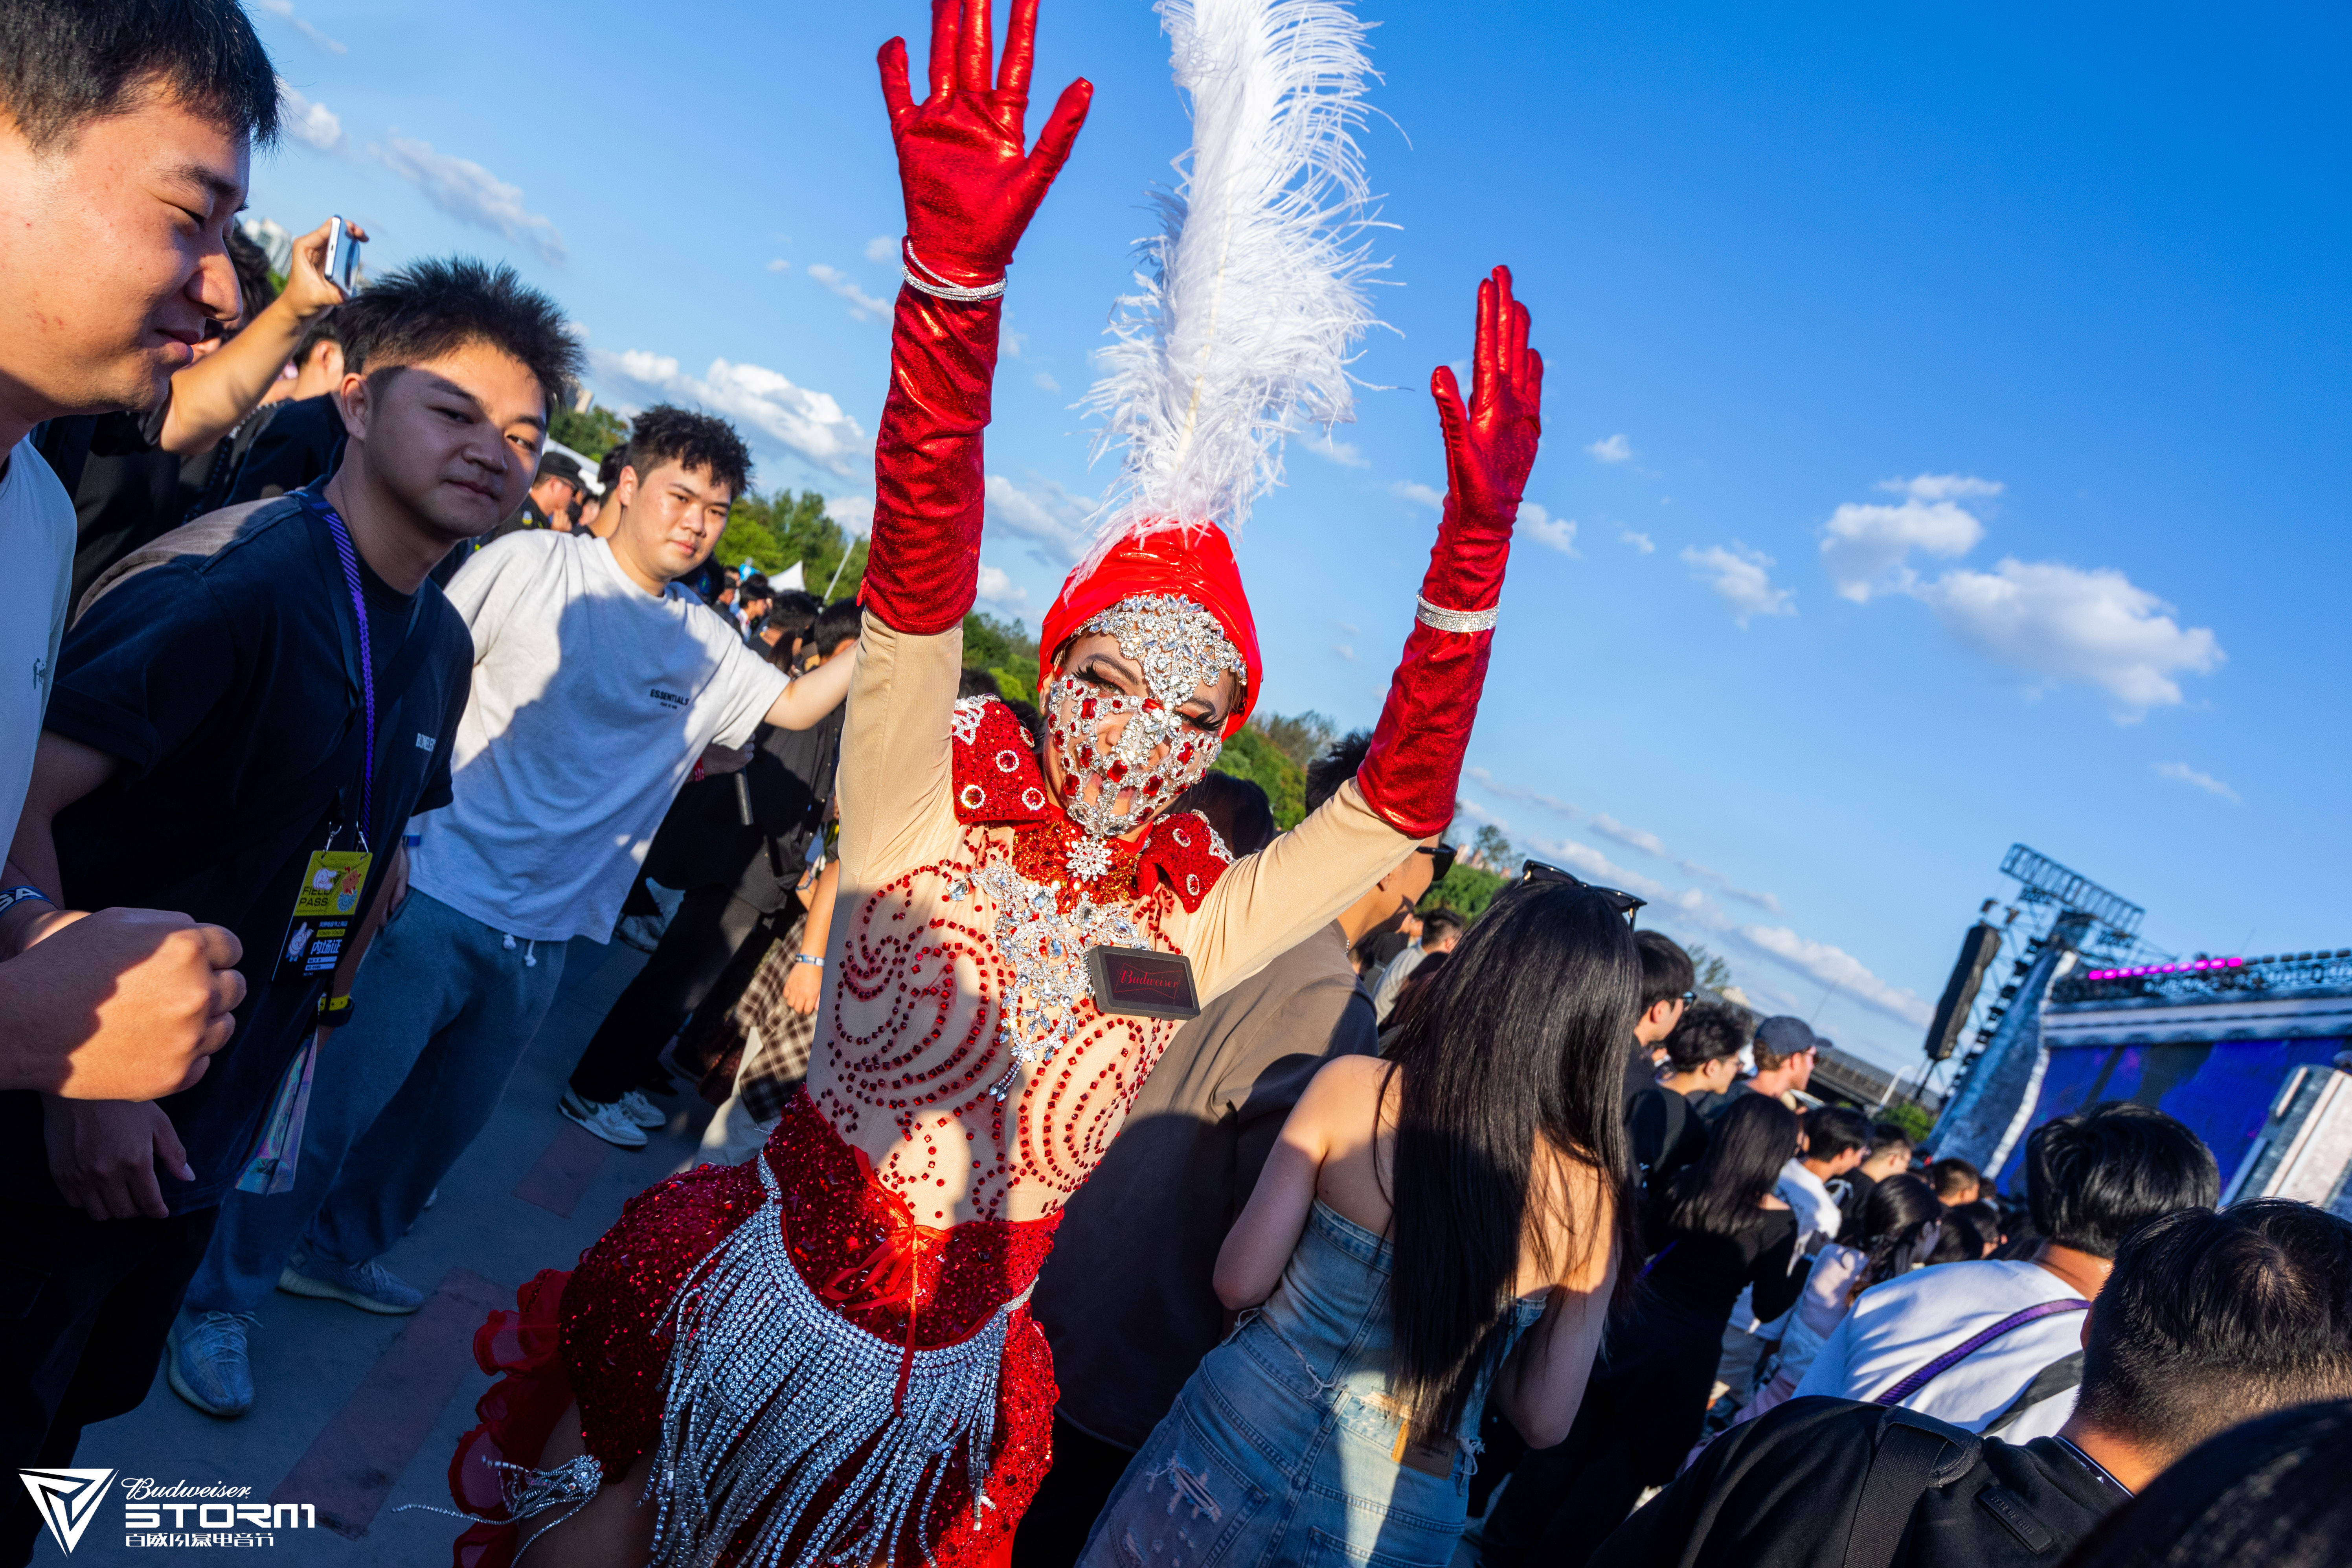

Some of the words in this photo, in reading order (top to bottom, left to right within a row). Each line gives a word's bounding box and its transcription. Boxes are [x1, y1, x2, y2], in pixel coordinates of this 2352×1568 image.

[650, 689, 689, 705] ESSENTIALS
[299, 897, 328, 906] PASS
[311, 939, 342, 955] 内场证
[1118, 969, 1178, 987] Budweiser
[1991, 1496, 2008, 1511] FEAR
[2006, 1509, 2019, 1518] OF
[2016, 1518, 2034, 1534] GOD
